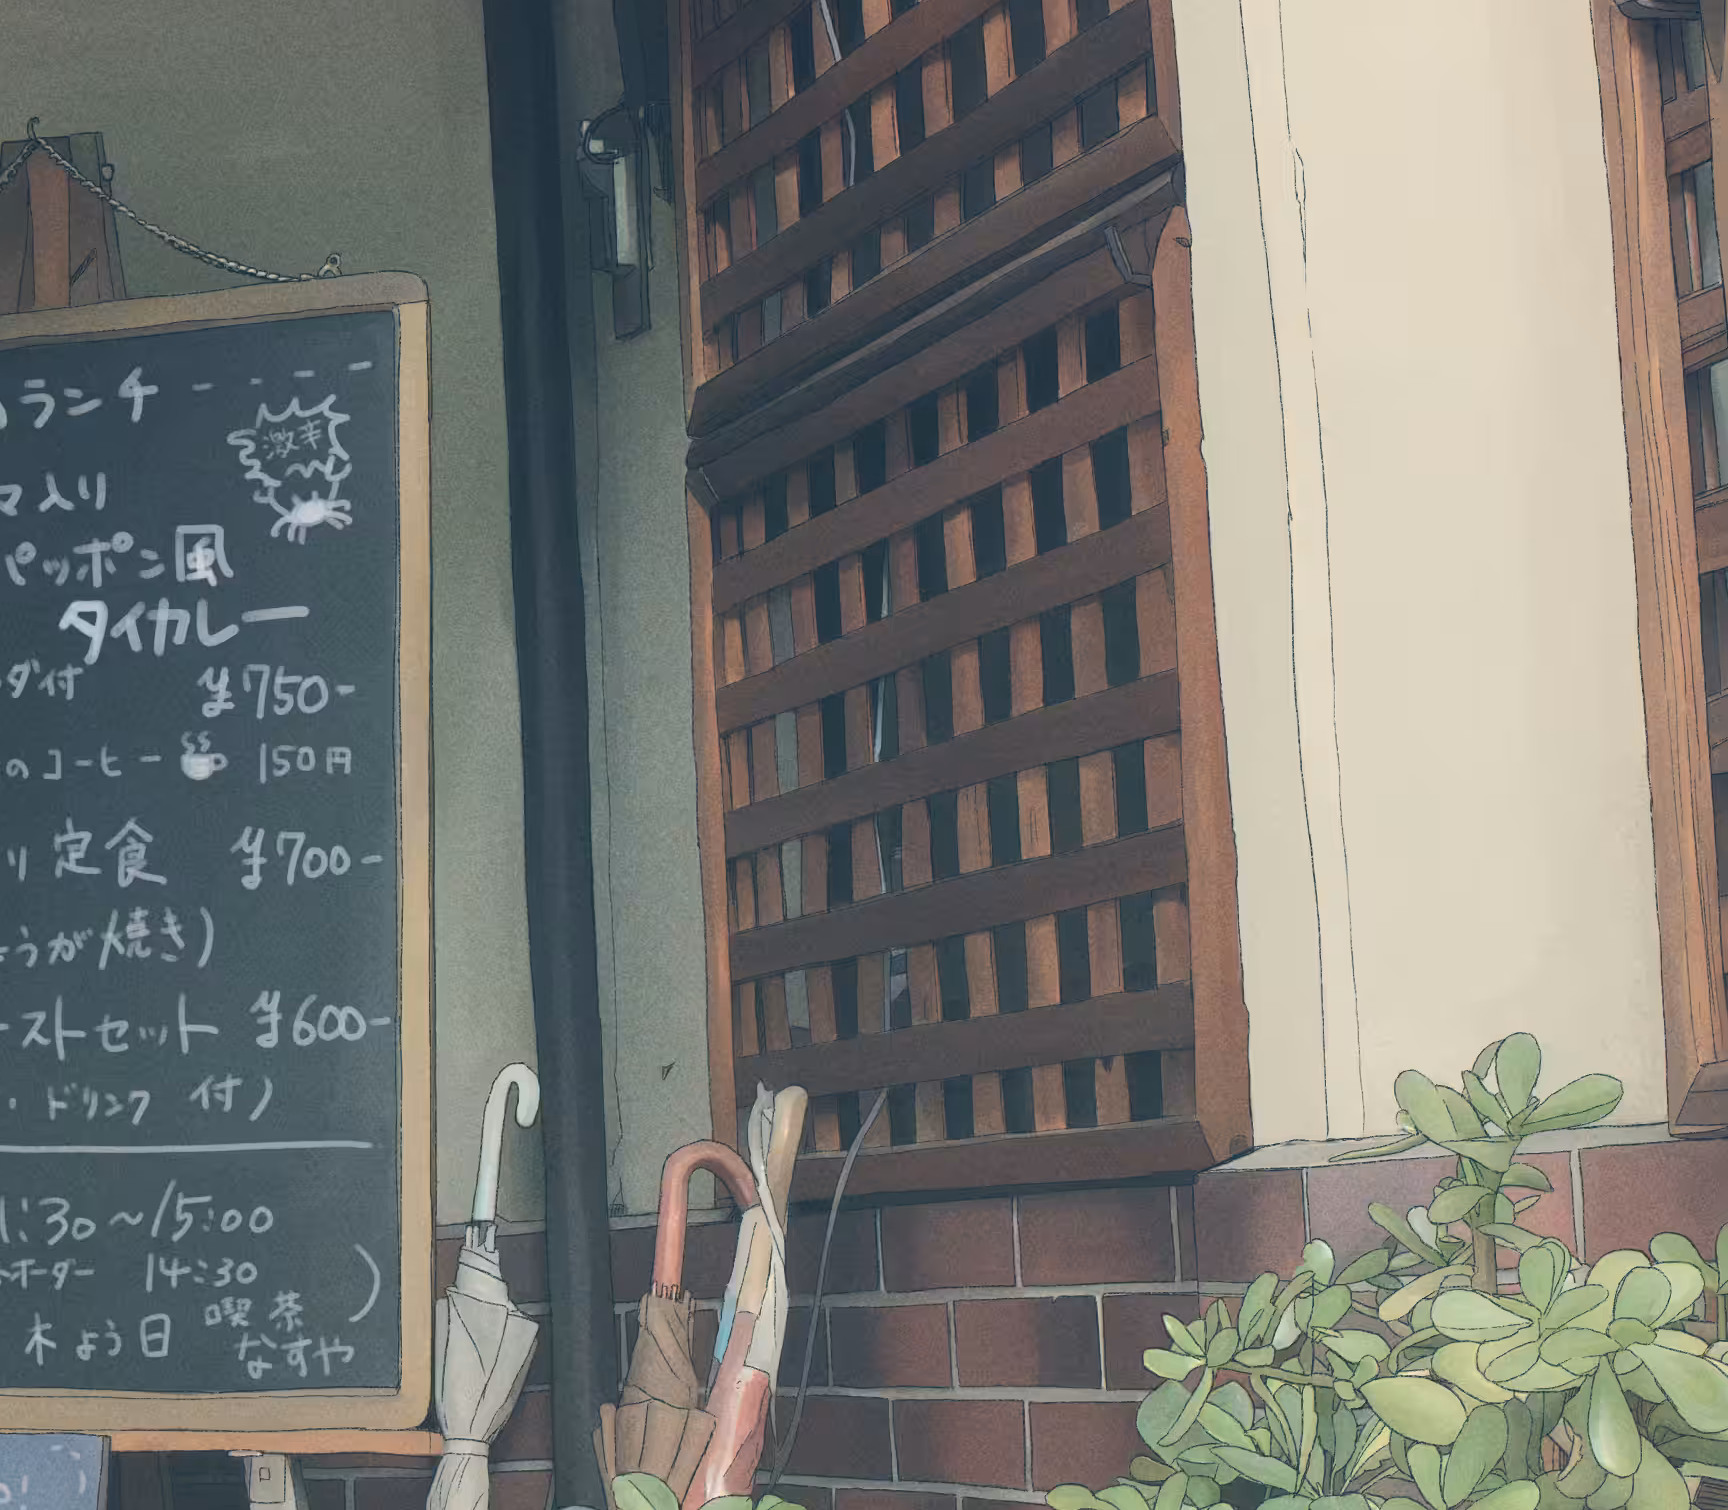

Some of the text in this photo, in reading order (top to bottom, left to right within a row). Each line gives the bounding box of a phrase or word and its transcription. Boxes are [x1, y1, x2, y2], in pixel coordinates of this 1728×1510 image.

[57, 598, 311, 666] タイカレー
[259, 743, 352, 785] 150円
[204, 1289, 305, 1334] 喫茶
[234, 1330, 355, 1380] なすや
